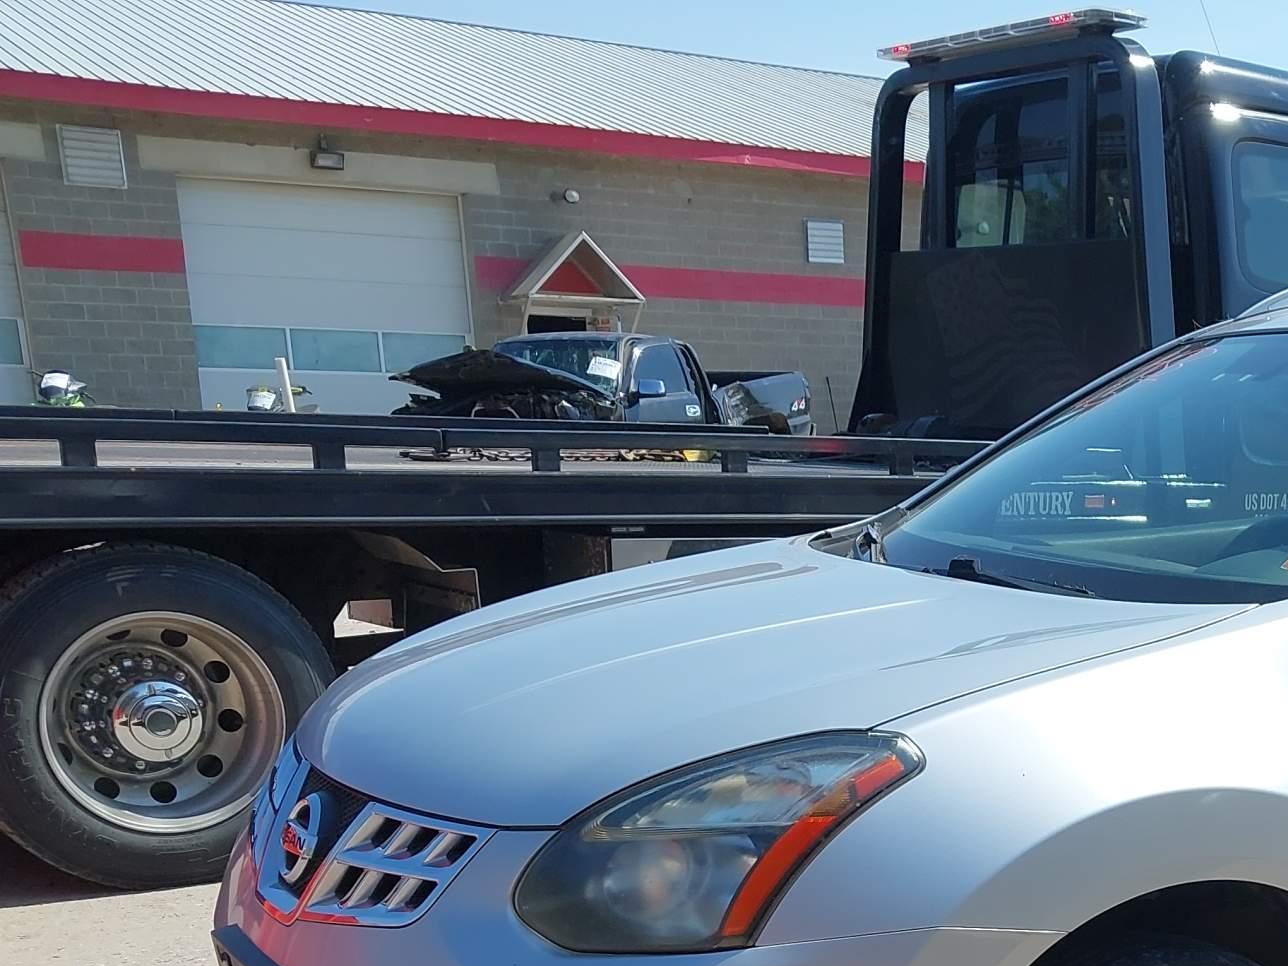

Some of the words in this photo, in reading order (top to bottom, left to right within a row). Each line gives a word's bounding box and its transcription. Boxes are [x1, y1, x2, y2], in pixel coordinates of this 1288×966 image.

[1000, 492, 1073, 515] ENTURY
[1245, 493, 1258, 511] US
[1260, 493, 1279, 510] DOT
